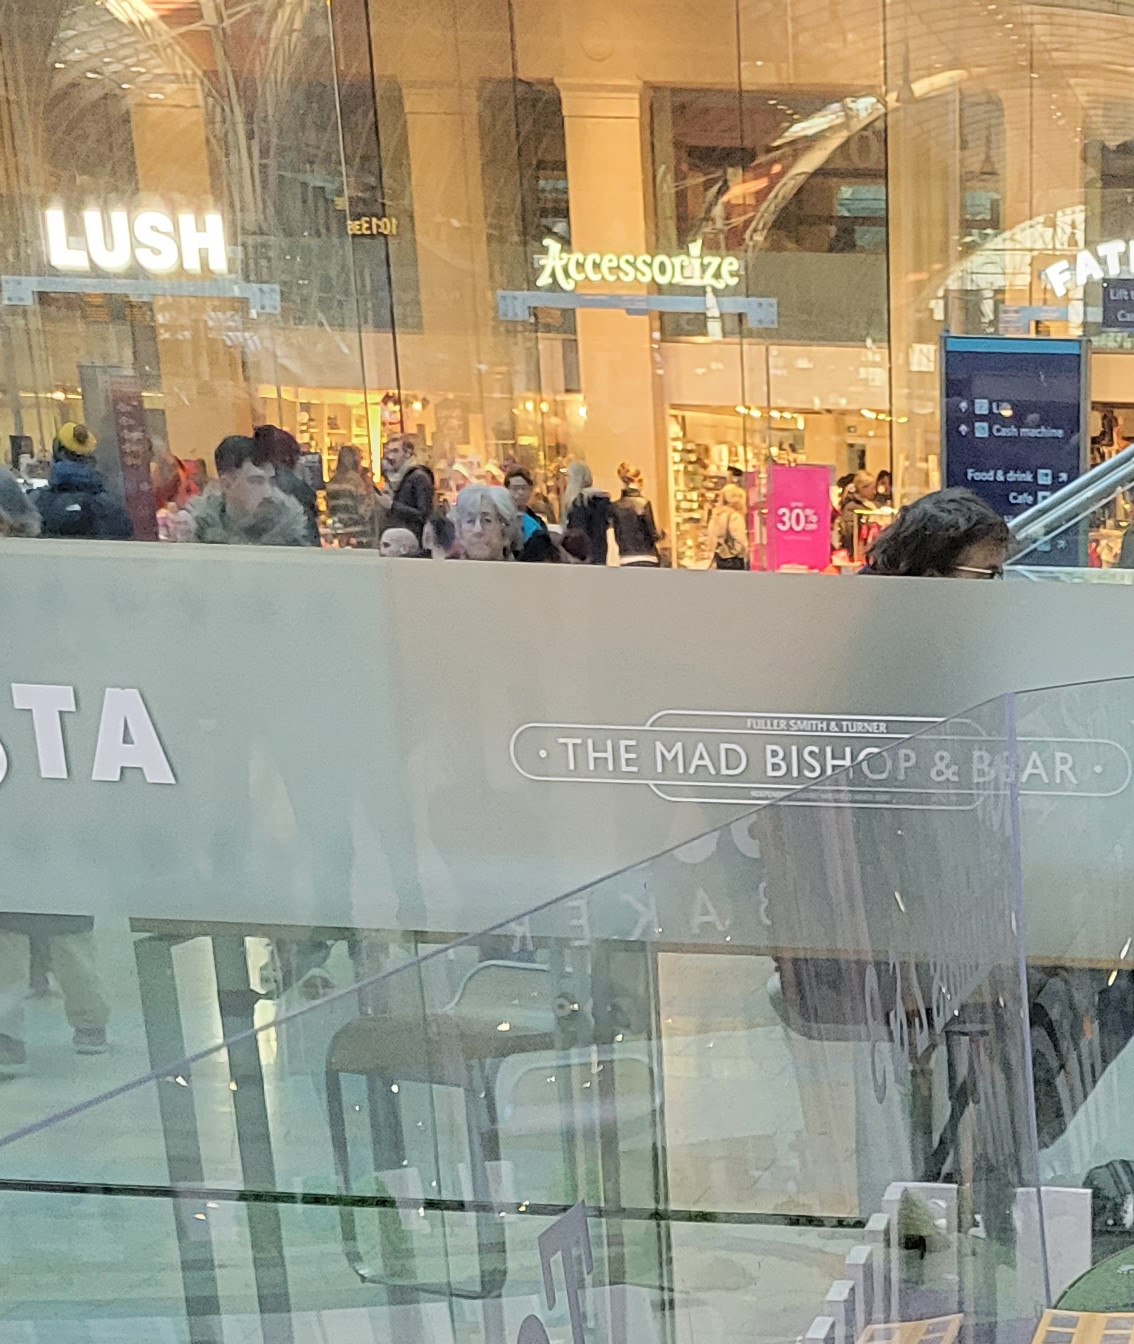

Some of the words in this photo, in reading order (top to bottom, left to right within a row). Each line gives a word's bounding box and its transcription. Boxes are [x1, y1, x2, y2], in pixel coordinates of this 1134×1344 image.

[45, 209, 228, 275] LUSH
[535, 238, 740, 291] Accessorize
[992, 424, 1018, 437] Cash
[1020, 425, 1064, 438] machine
[966, 468, 995, 481] Food
[996, 469, 1005, 482] &
[1006, 470, 1034, 482] drink
[0, 683, 177, 785] TA
[746, 718, 788, 731] FULLER
[789, 719, 827, 732] SMITH
[828, 720, 840, 732] &
[841, 721, 887, 733] TURNER
[557, 738, 639, 773] THE
[654, 741, 748, 776] MAD
[765, 744, 916, 782] BISHOP
[929, 750, 959, 783] &
[972, 749, 1079, 785] BEAR
